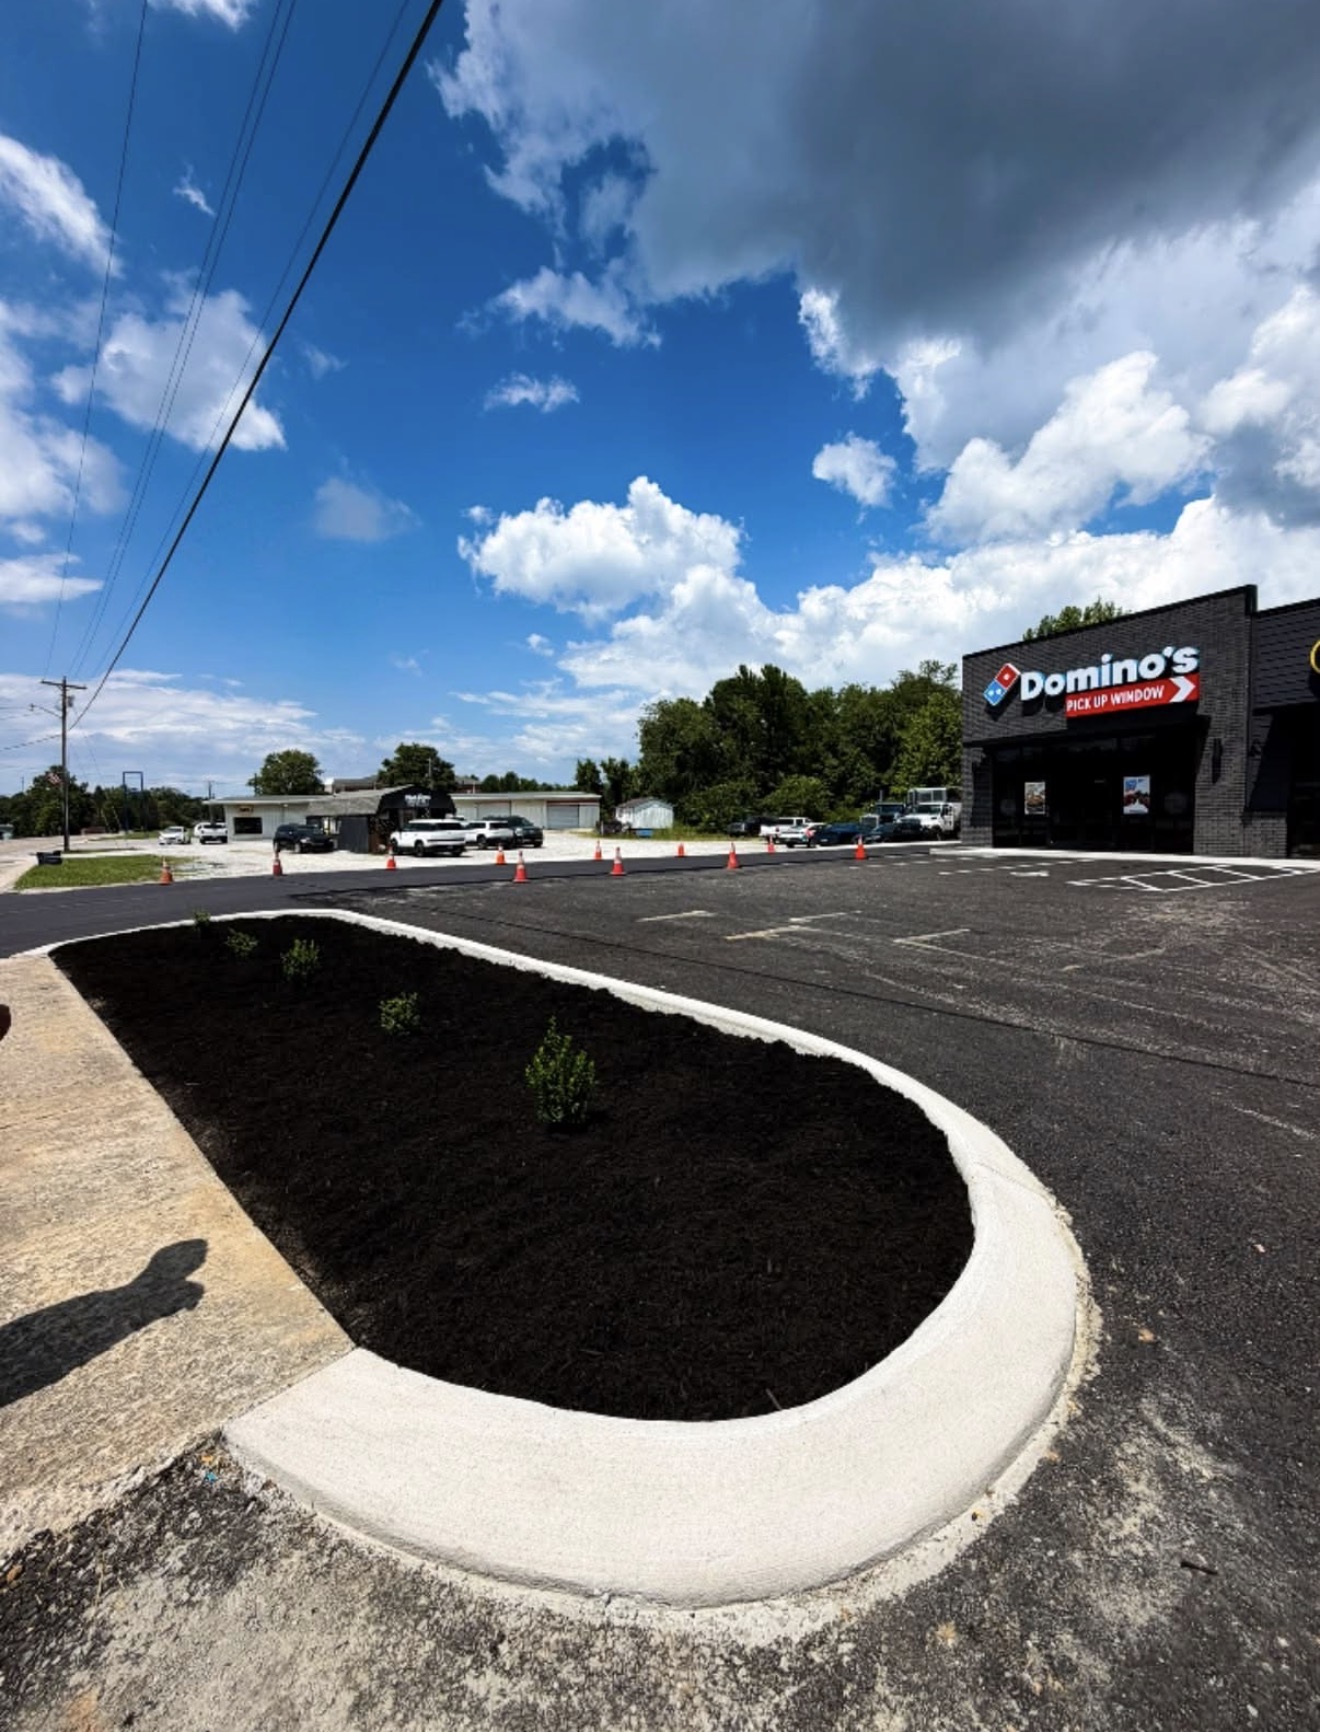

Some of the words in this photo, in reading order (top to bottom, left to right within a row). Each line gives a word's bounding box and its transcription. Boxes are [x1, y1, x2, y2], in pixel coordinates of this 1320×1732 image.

[1020, 646, 1199, 700] Domino's
[1066, 699, 1091, 712] PICK
[1094, 694, 1108, 707] UP
[1111, 685, 1164, 706] WINDOW
